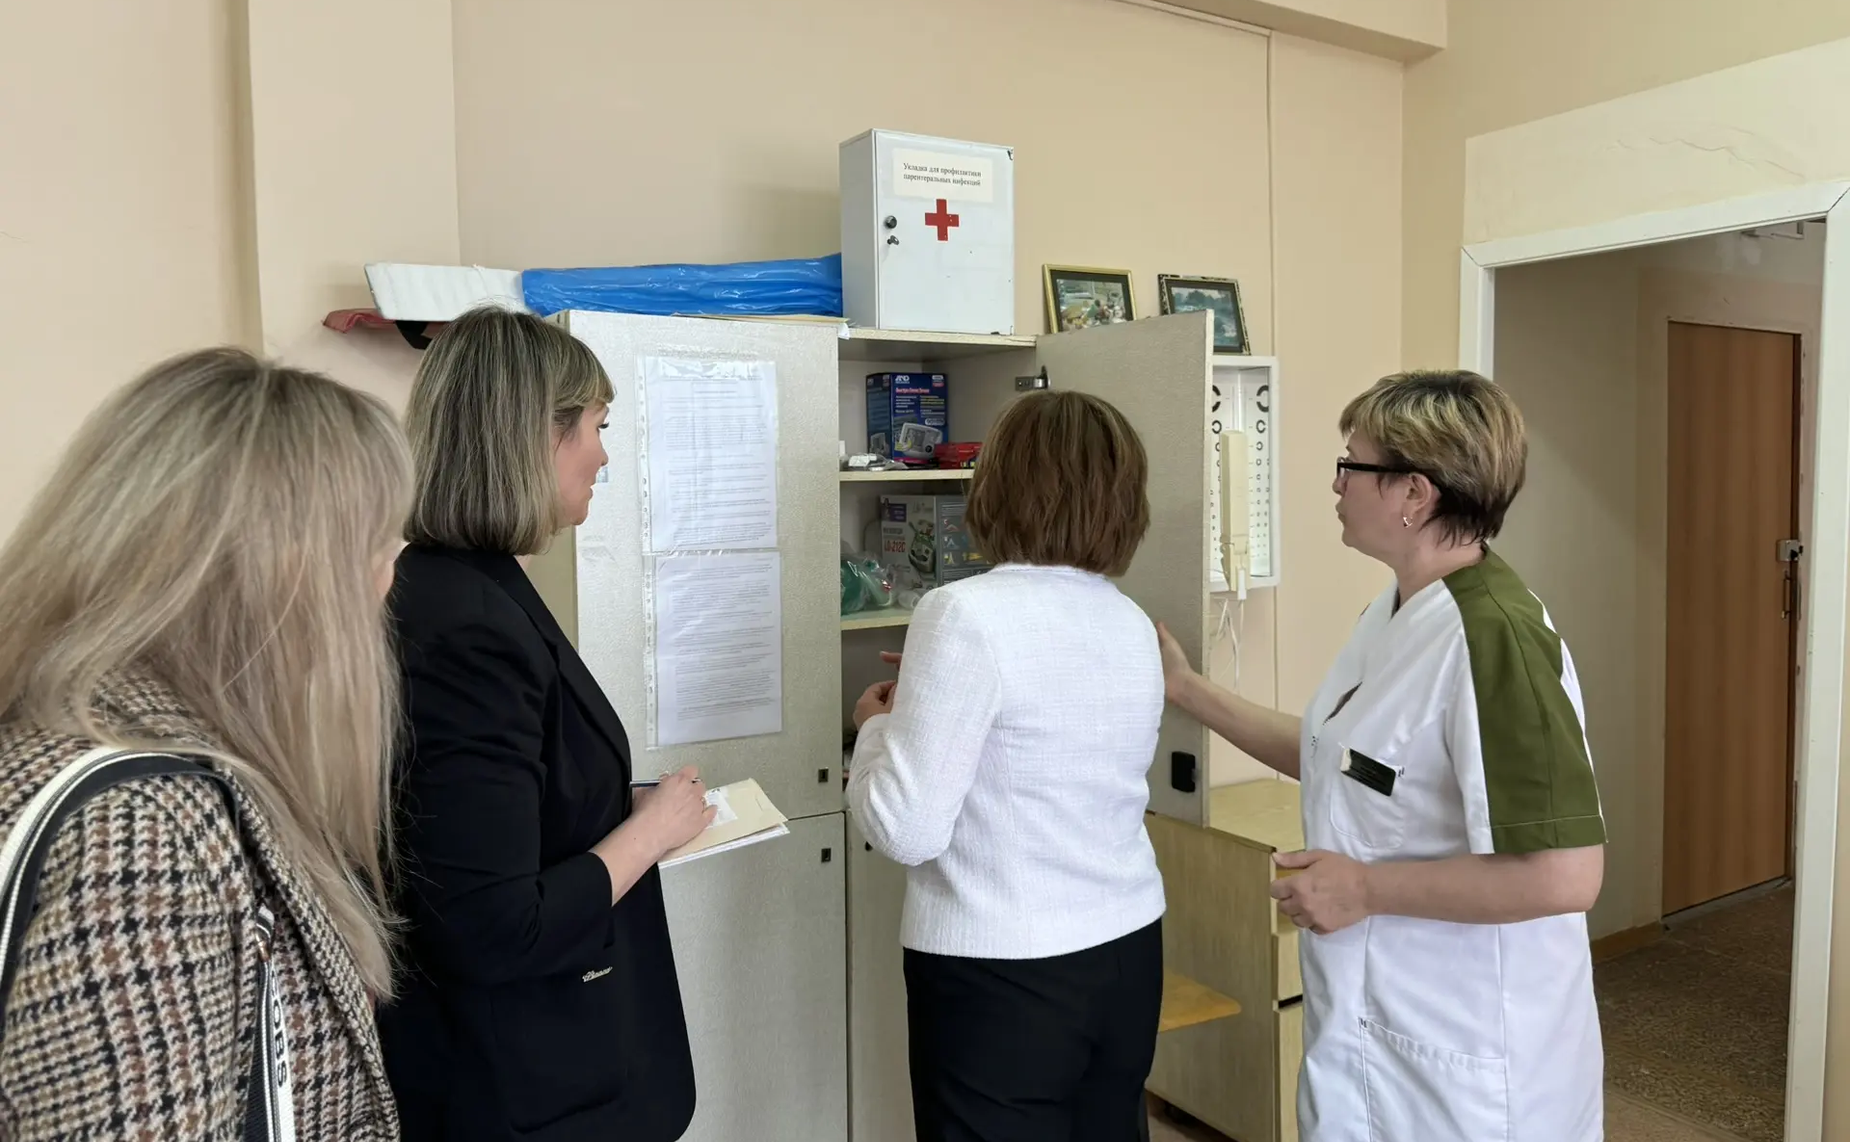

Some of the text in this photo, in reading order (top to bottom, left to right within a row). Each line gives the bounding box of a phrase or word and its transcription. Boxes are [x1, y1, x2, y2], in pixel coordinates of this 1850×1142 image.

[903, 162, 928, 172] Укладка
[940, 167, 981, 177] профилактики
[903, 173, 981, 186] парентеральных инфекций
